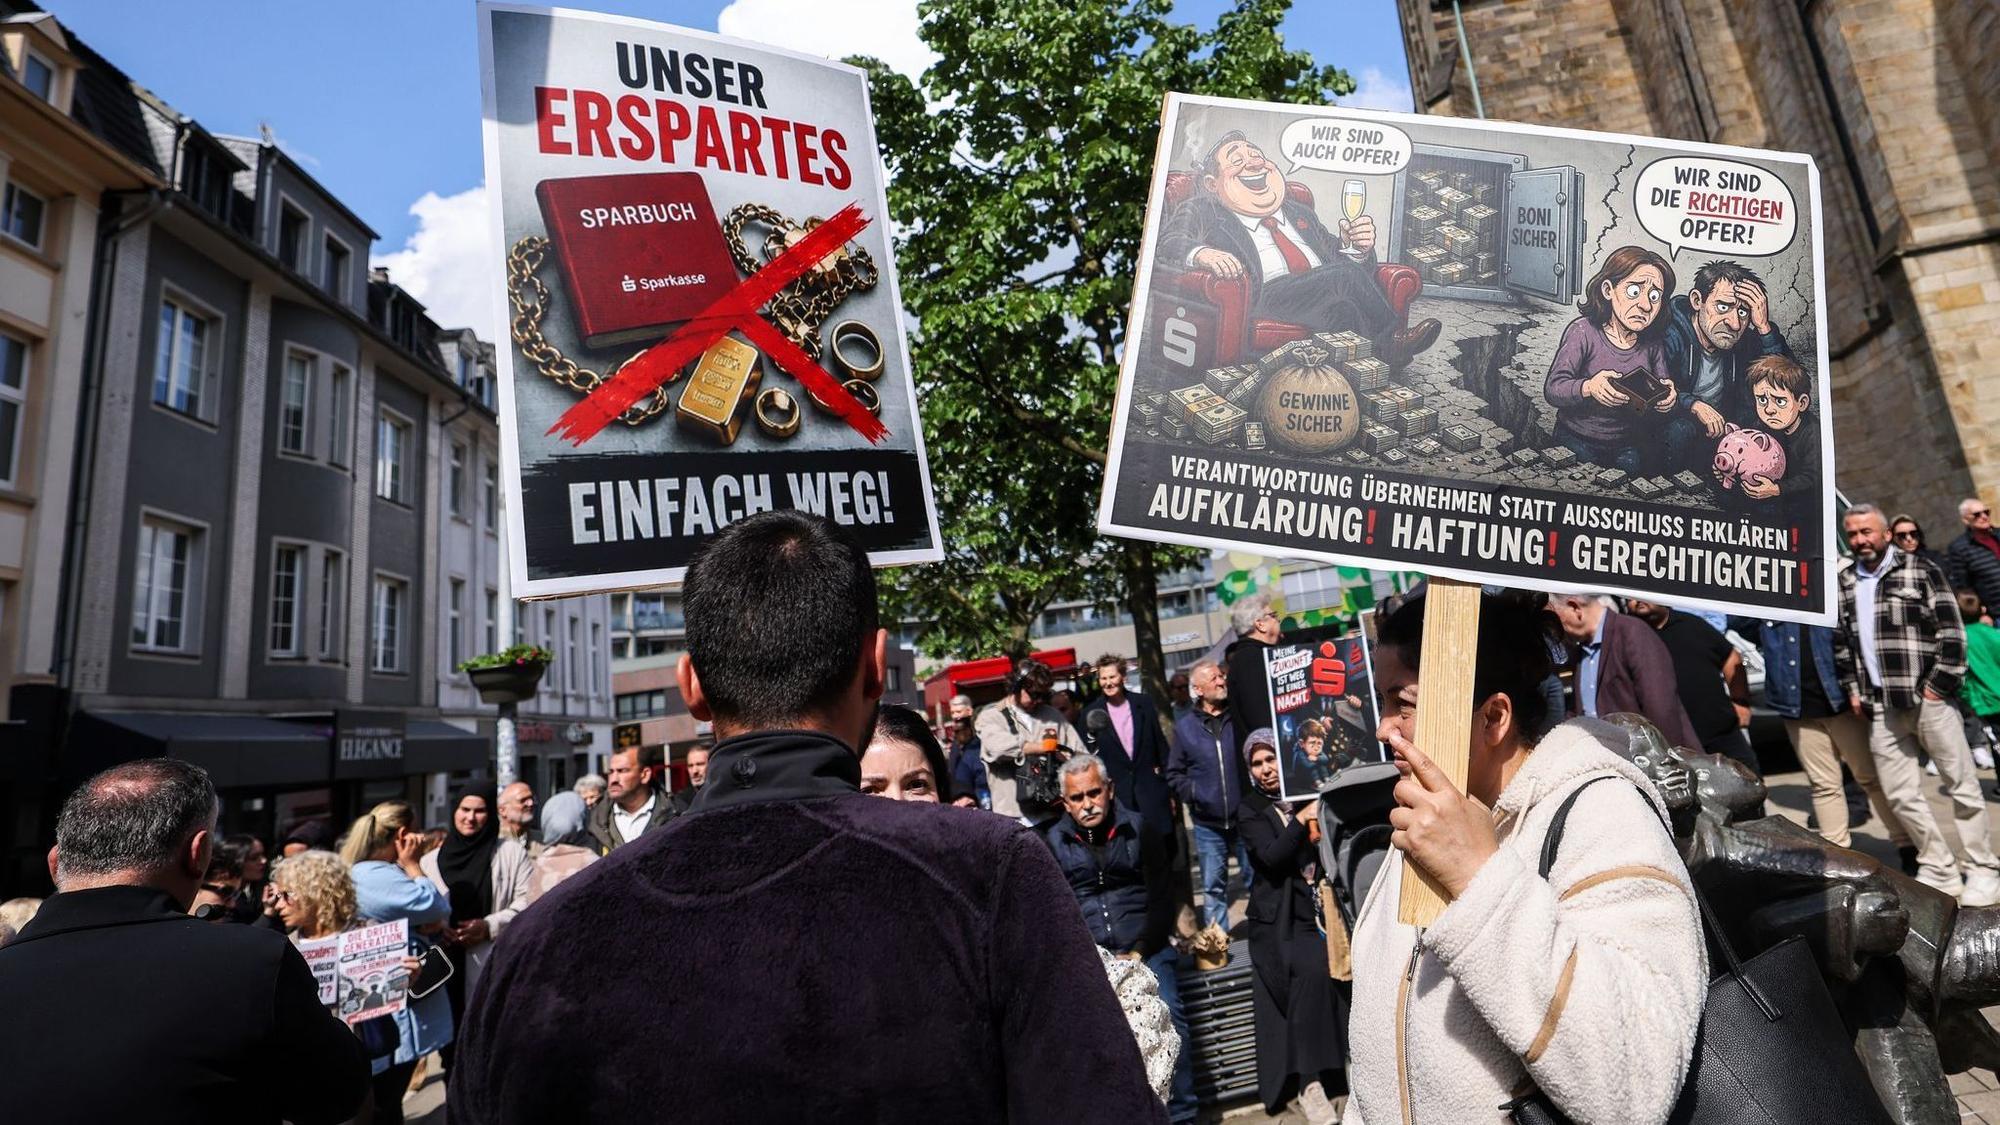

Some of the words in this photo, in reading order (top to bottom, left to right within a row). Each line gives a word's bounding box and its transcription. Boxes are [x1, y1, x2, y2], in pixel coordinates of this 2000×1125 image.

[616, 41, 768, 109] UNSER
[535, 86, 852, 190] ERSPARTES
[1311, 125, 1341, 142] WIR
[1347, 129, 1384, 146] SIND
[1292, 142, 1336, 161] AUCH
[1342, 147, 1400, 166] OPFER!
[1674, 166, 1709, 188] WIR
[1717, 171, 1762, 193] SIND
[1651, 187, 1681, 209] DIE
[1687, 190, 1783, 220] RICHTIGEN
[580, 202, 698, 229] SPARBUCH
[1517, 206, 1552, 227] BONI
[1511, 227, 1557, 250] SICHER
[1680, 218, 1755, 246] OPFER!
[640, 271, 706, 291] Sparkasse
[1279, 391, 1350, 411] GEWINNE
[1285, 413, 1343, 433] SICHER
[568, 473, 775, 545] EINFACH
[787, 470, 895, 527] WEG!
[1170, 454, 1353, 500] VERANTWORTUNG
[1361, 474, 1492, 515] ÜBERNEHMEN
[1499, 495, 1557, 523] STATT
[1562, 503, 1685, 539] AUSSCHLUSS
[1691, 518, 1799, 553] ERKLÄREN!
[1148, 482, 1377, 545] AUFKLÄRUNG!
[1391, 512, 1558, 567] HAFTUNG!
[1571, 534, 1809, 598] GERECHTIGKEIT!
[1273, 646, 1297, 660] MEINE
[1273, 653, 1310, 674] ZUKUNFT
[1278, 674, 1288, 686] IST
[1289, 669, 1305, 682] WEG
[1278, 687, 1285, 695] IN
[1286, 680, 1307, 692] EINER
[1275, 689, 1310, 711] NACHT.
[340, 738, 402, 760] ELEGANCE
[344, 933, 403, 954] GENERATION
[348, 931, 362, 943] DIE
[367, 923, 400, 939] DRITTE
